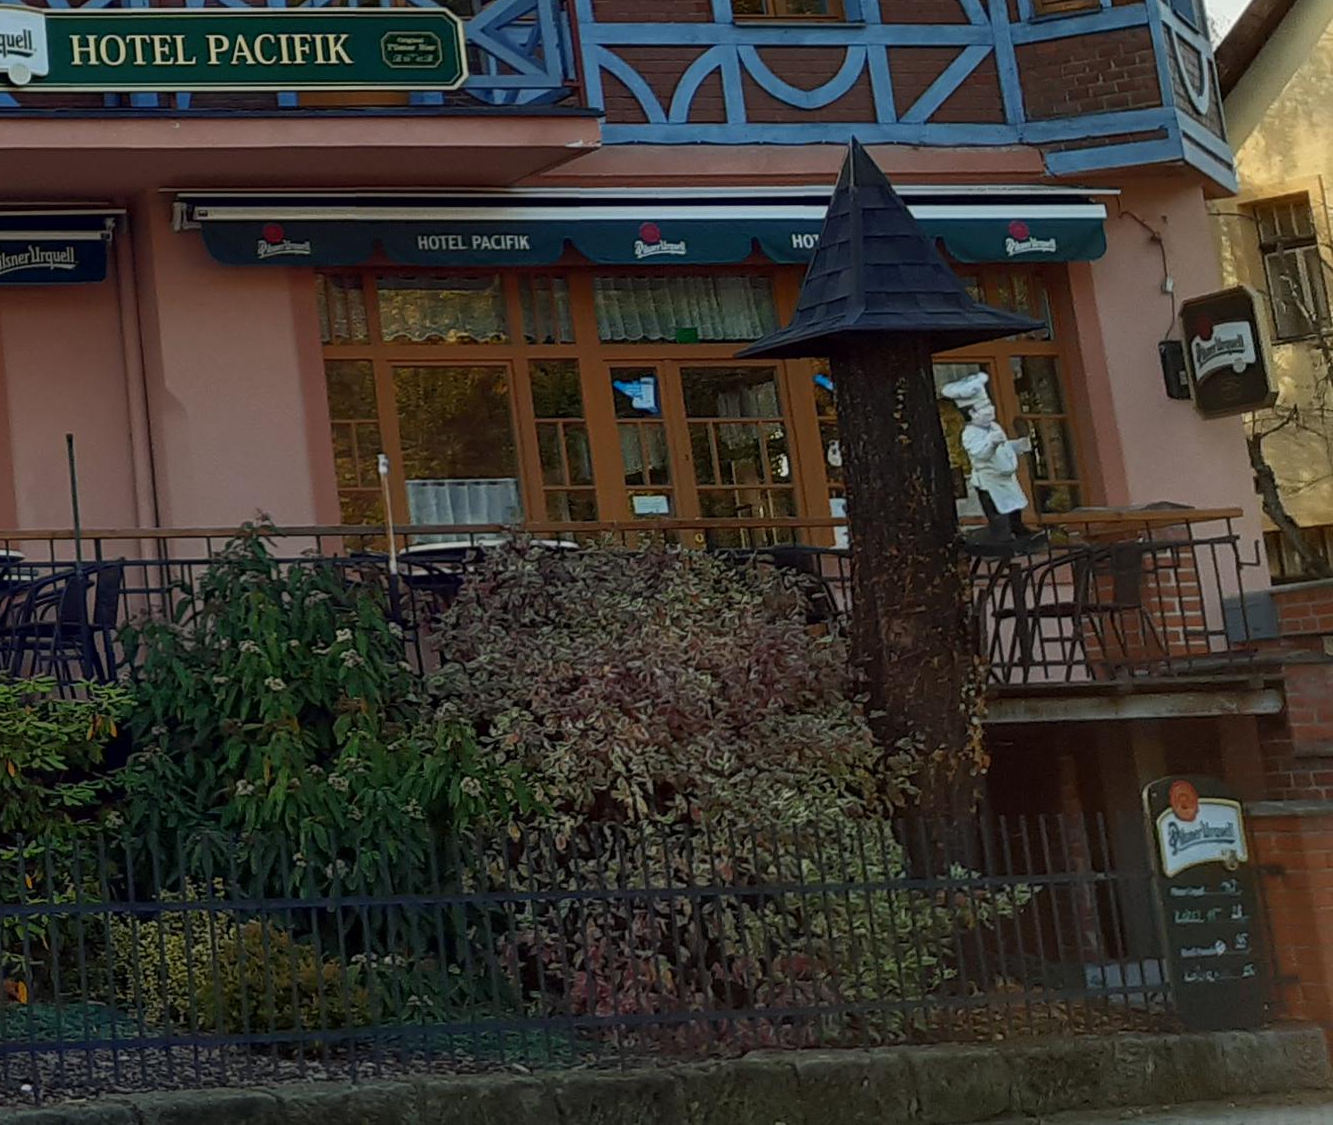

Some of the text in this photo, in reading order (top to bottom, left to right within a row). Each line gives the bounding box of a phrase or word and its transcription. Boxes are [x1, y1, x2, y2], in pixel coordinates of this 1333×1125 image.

[69, 33, 354, 66] HOTEL PACIFIK
[417, 235, 530, 250] HOTEL PACIFIK
[27, 245, 75, 270] Urquell
